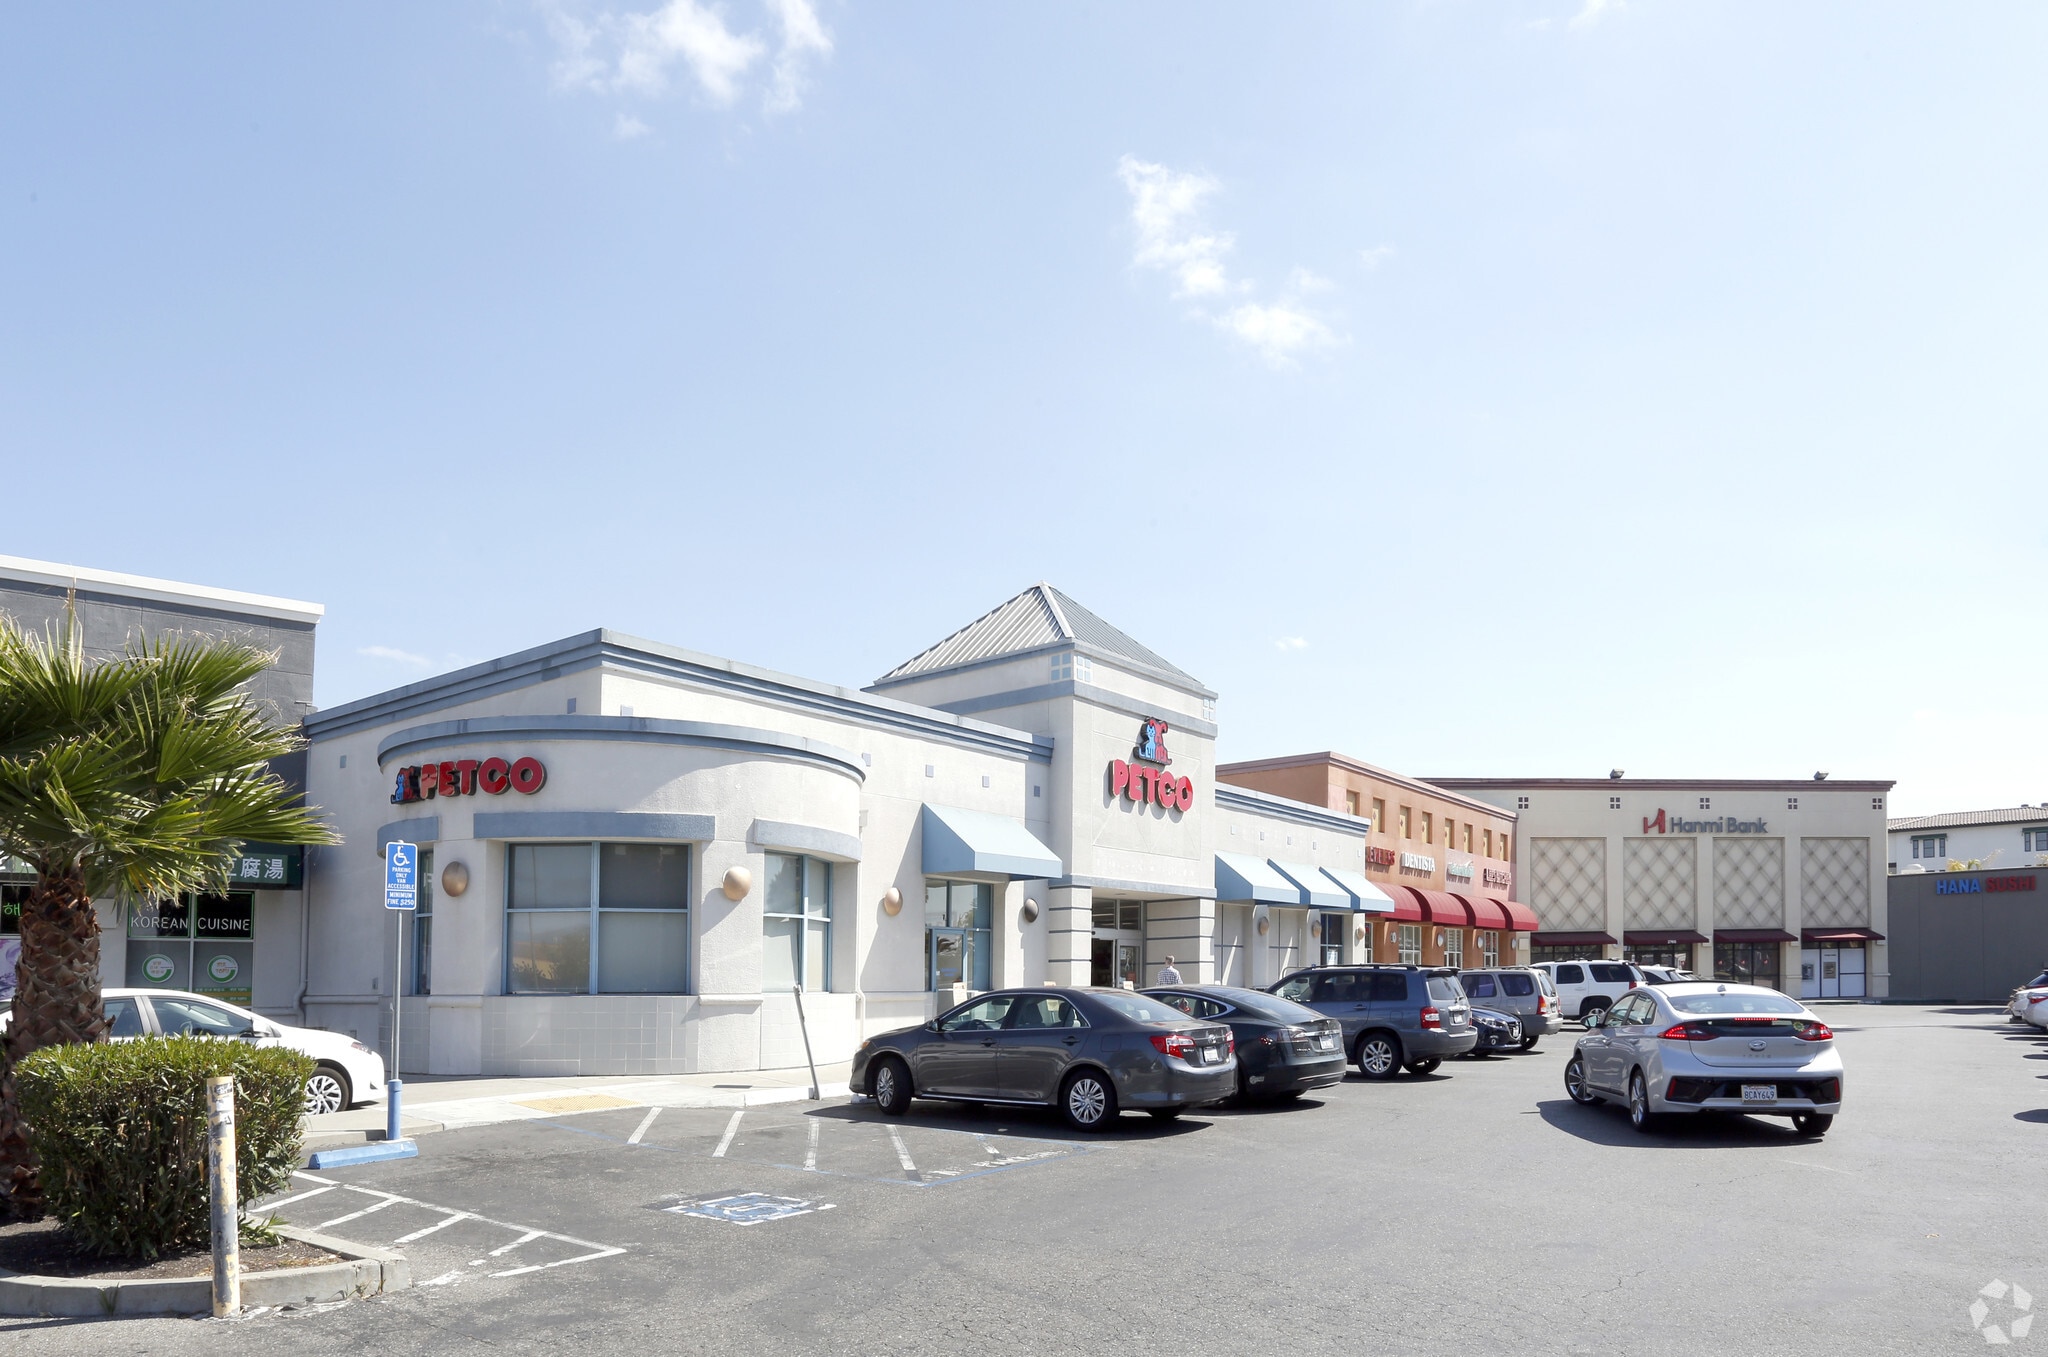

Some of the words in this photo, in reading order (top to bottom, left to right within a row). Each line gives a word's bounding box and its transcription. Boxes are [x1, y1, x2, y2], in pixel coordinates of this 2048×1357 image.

[420, 756, 546, 800] PETCO
[1110, 759, 1194, 812] PETCO
[1671, 816, 1723, 833] Hanmi
[1727, 817, 1768, 833] Bank
[1402, 852, 1436, 872] DENTISTA
[1936, 878, 1981, 895] HANA
[1985, 876, 2036, 893] SUSHI
[131, 916, 188, 929] KOREAN
[197, 917, 251, 931] CUISINE
